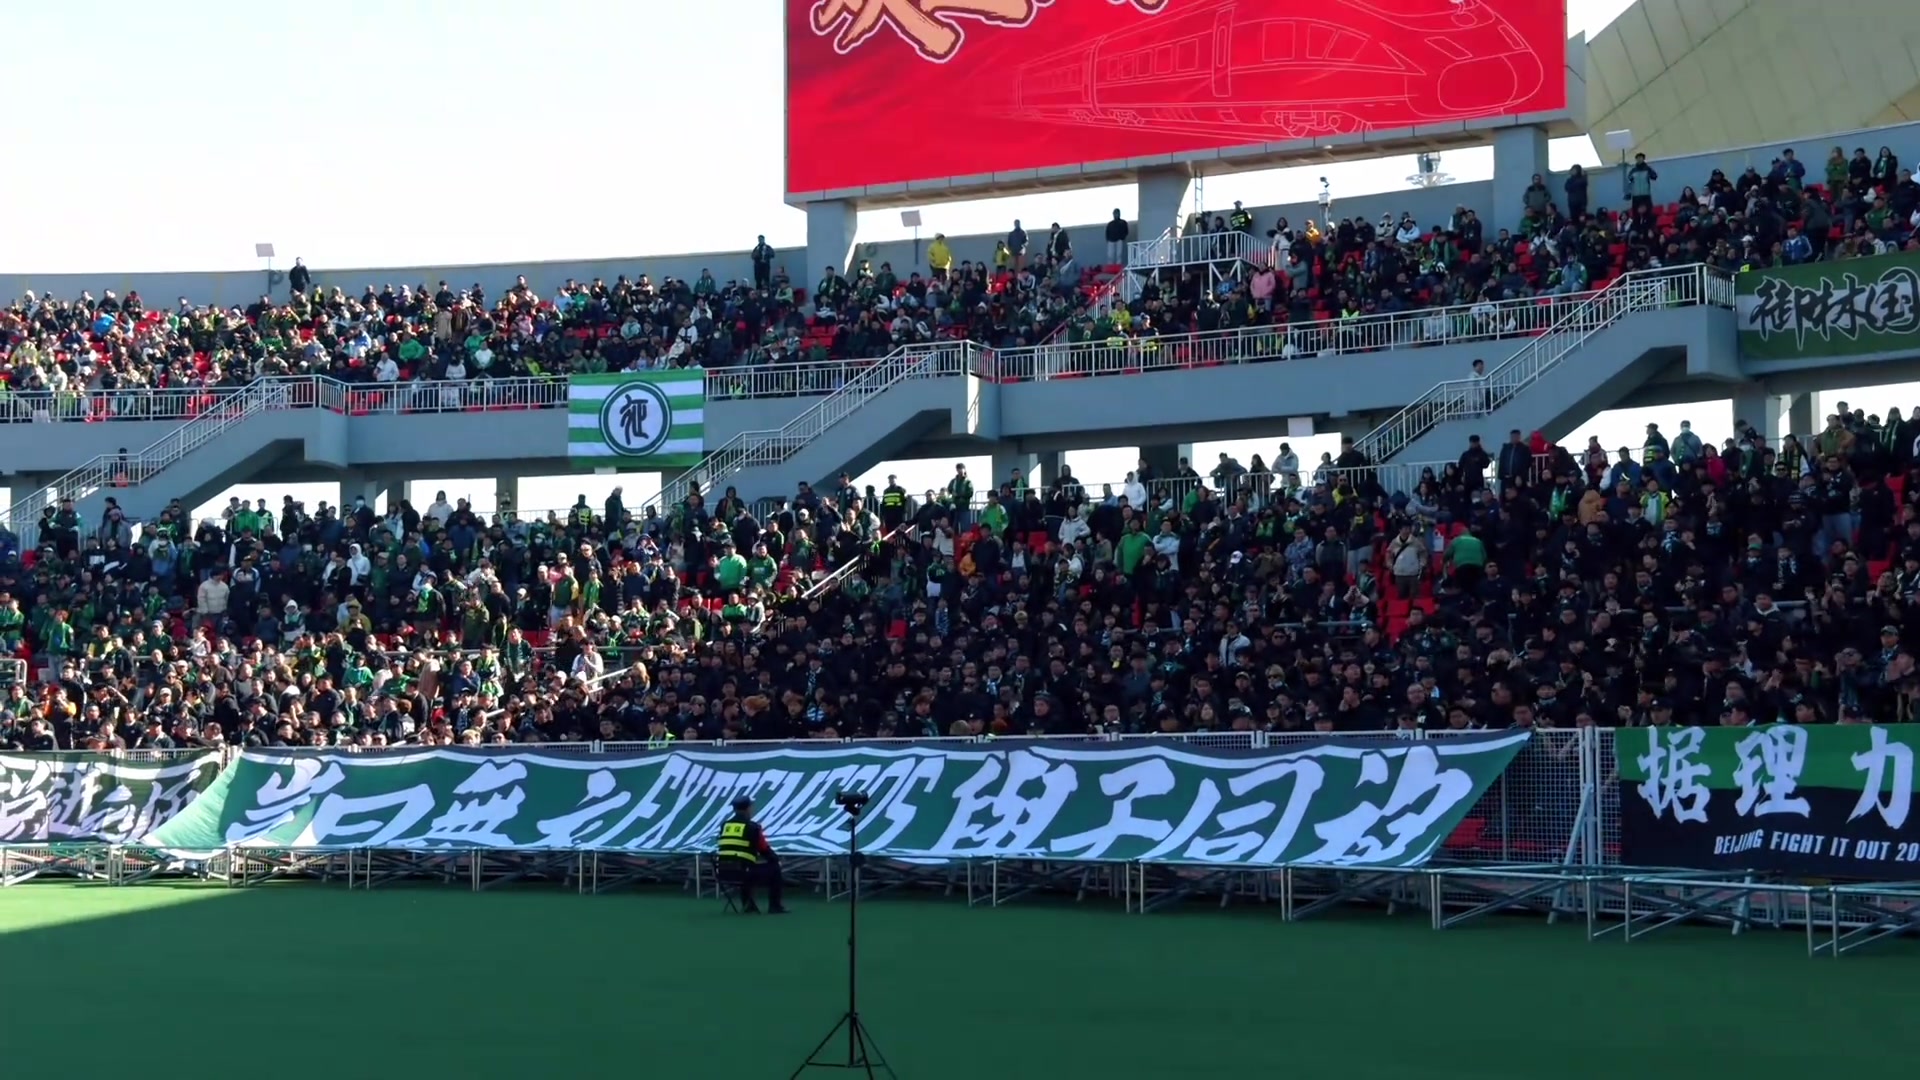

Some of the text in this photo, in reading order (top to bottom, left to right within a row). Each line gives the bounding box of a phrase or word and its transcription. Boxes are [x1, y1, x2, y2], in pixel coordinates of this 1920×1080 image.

[1637, 725, 1914, 829] 据理力
[1714, 829, 1920, 862] BEIJING FIGHT IT OUT 20
